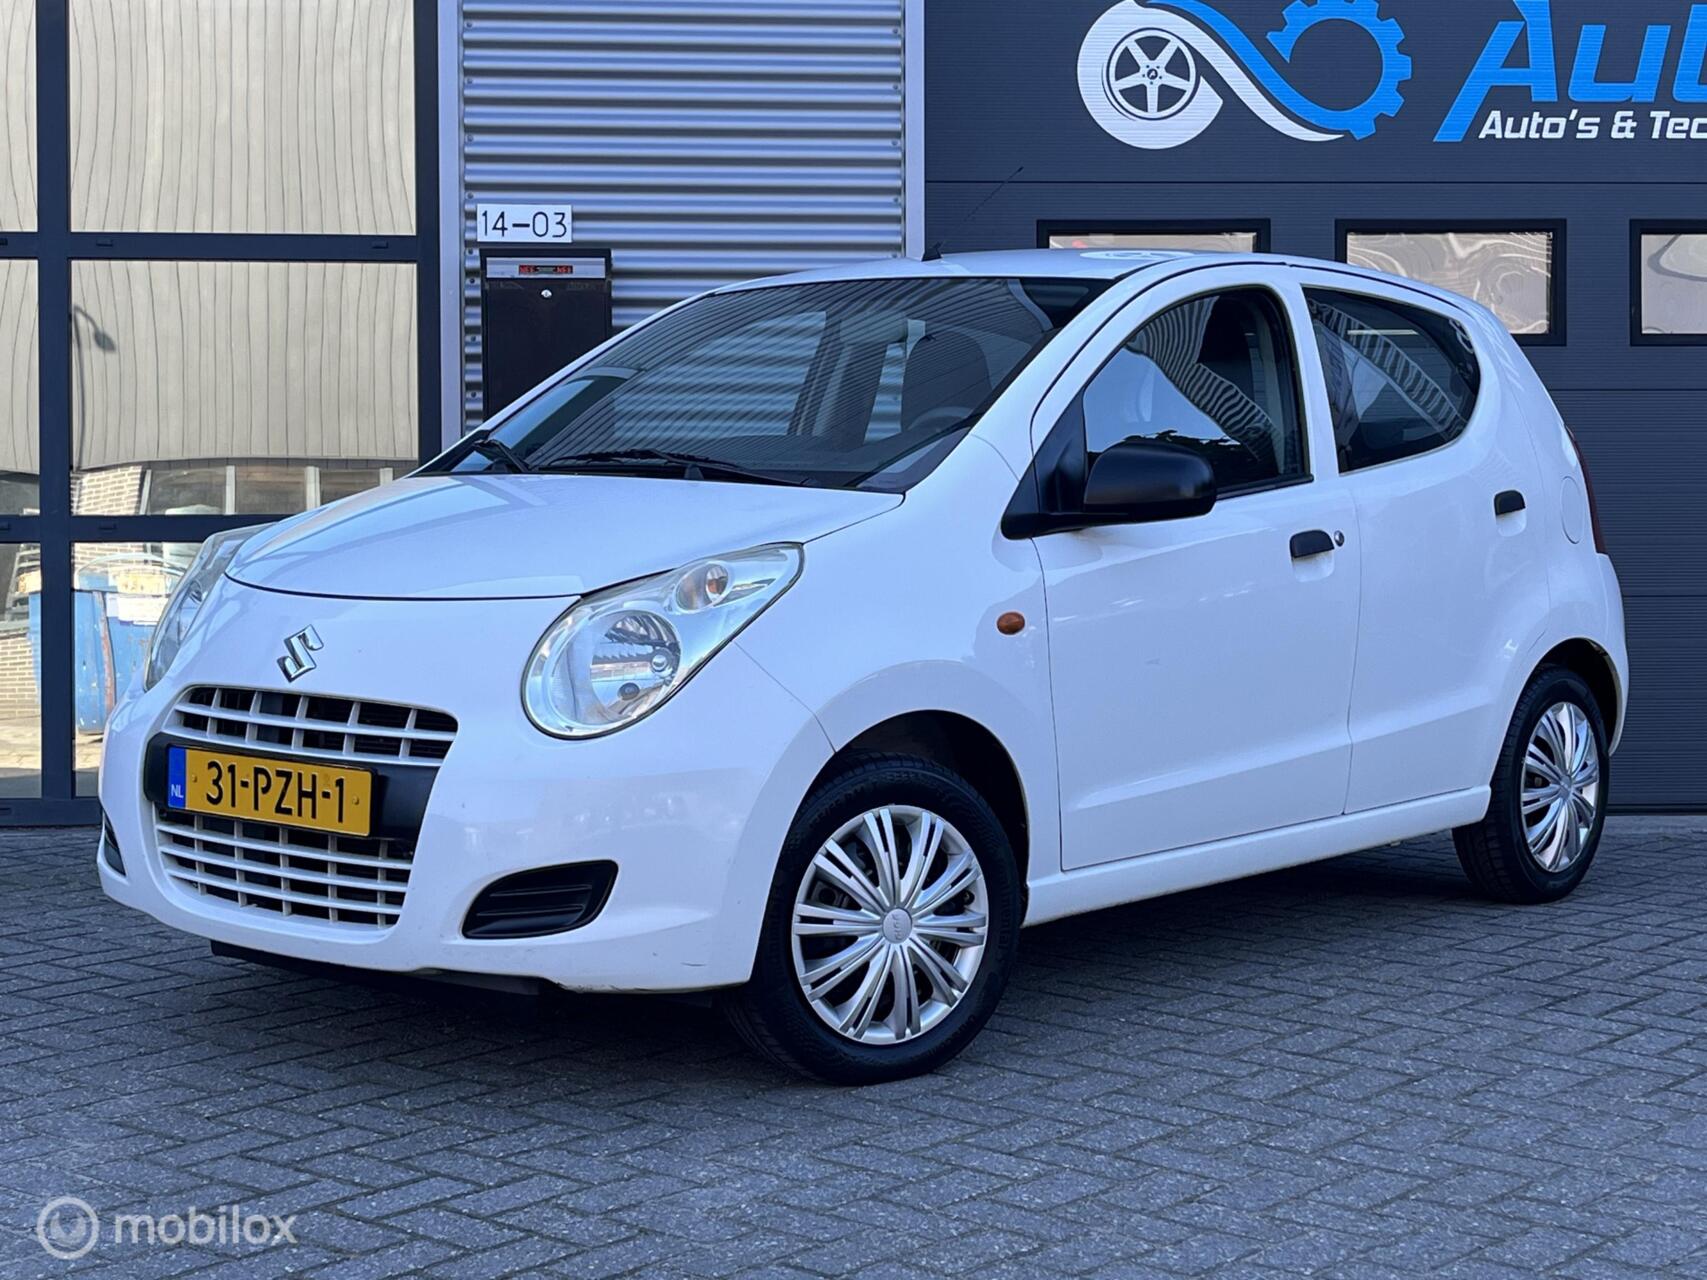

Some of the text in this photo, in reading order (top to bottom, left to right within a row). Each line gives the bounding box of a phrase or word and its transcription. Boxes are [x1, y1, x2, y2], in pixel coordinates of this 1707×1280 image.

[1478, 109, 1707, 140] Auto's & Tec
[481, 210, 568, 239] 14-03
[170, 783, 184, 798] NL
[205, 760, 345, 823] 31-PZH-1
